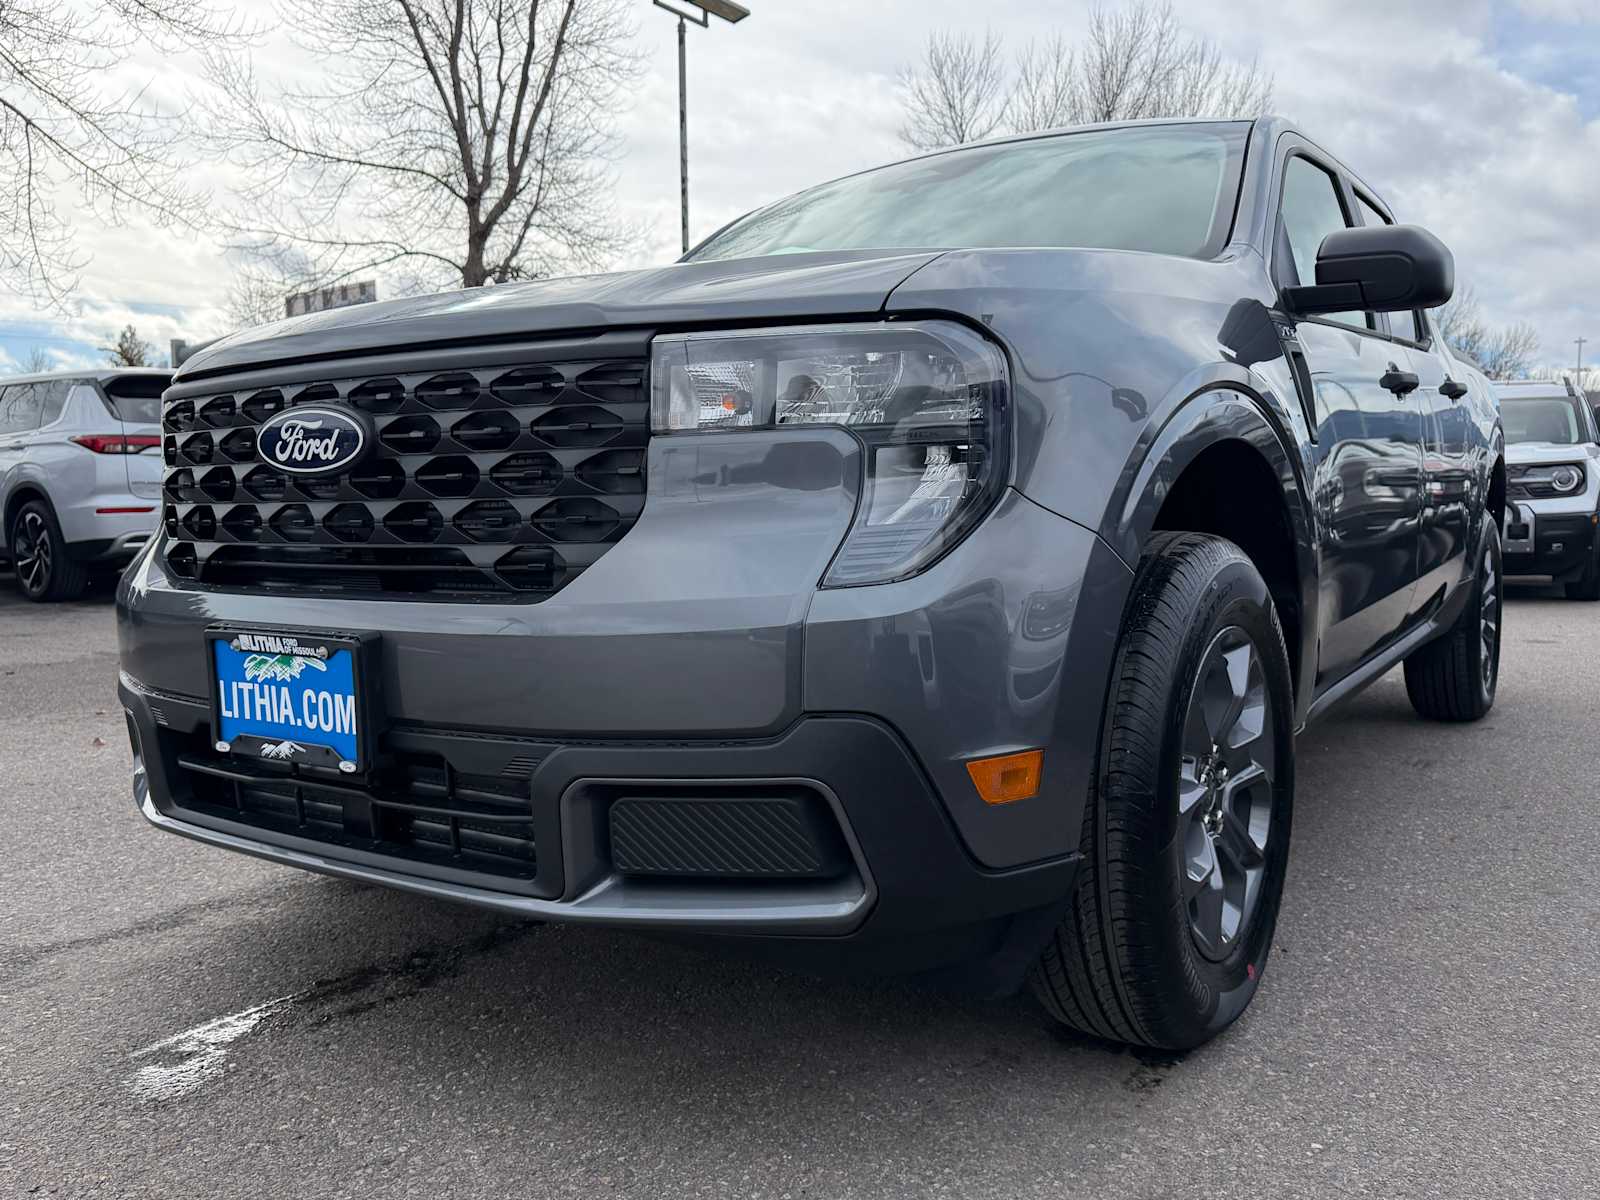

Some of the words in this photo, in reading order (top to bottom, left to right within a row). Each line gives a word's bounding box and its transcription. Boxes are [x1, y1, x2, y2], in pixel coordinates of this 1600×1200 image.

[275, 420, 340, 461] Ford
[248, 635, 284, 654] LITHIA
[283, 638, 298, 646] FORD
[219, 680, 356, 735] LITHIA.COM
